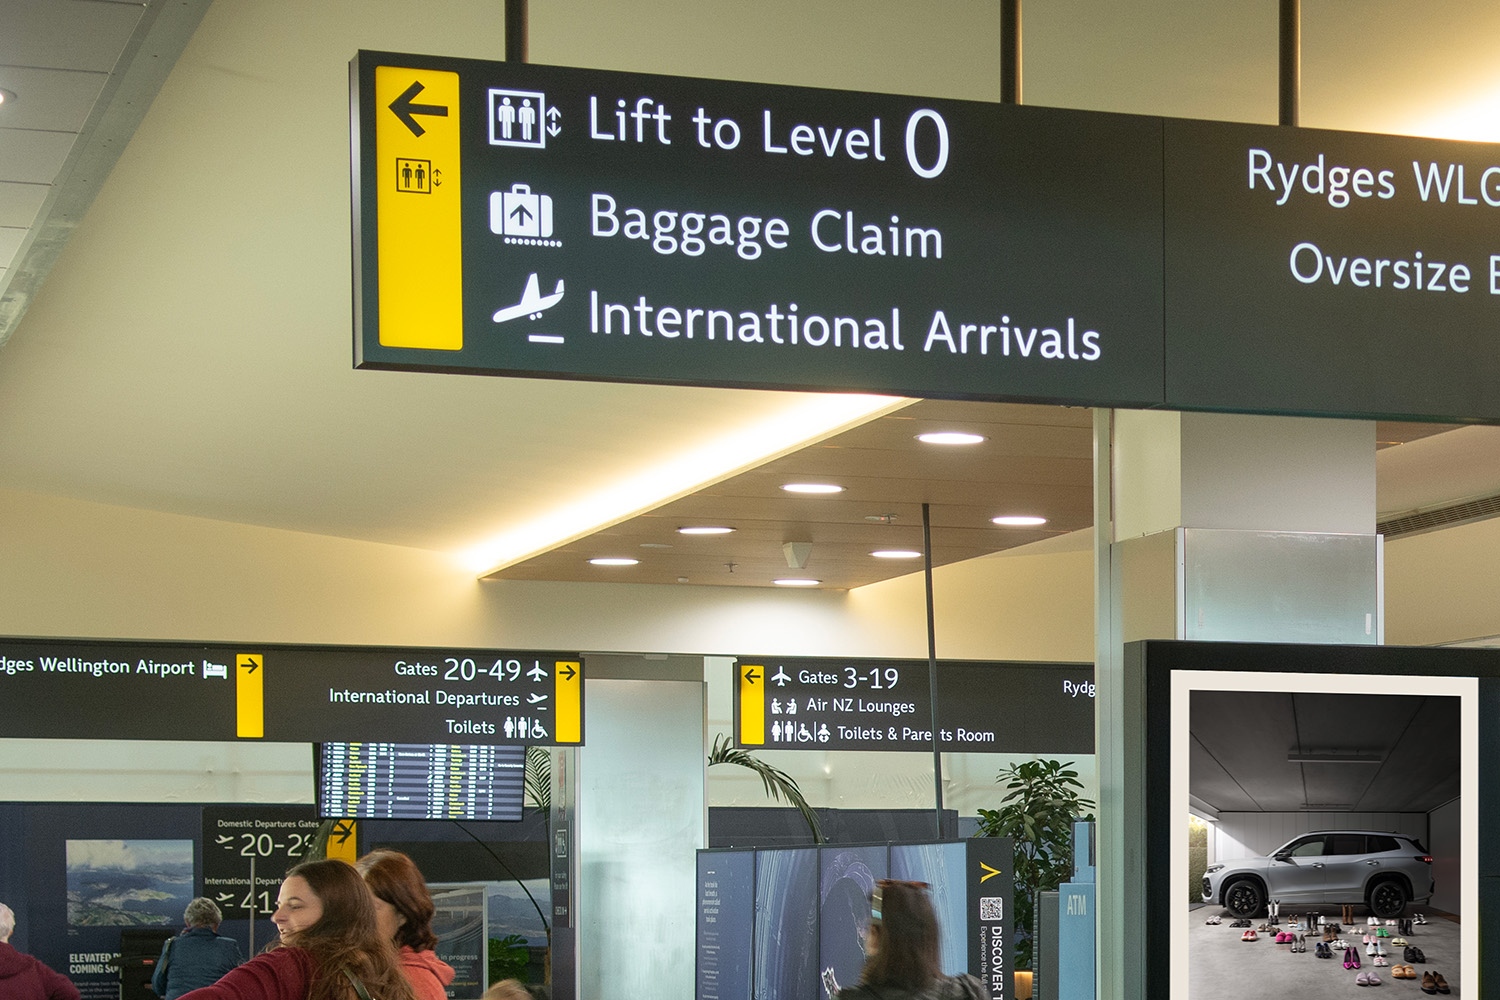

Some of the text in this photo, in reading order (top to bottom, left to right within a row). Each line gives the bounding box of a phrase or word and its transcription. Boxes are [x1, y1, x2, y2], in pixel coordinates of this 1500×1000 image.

[590, 96, 949, 178] Lift to Level 0
[1248, 148, 1395, 208] Rydges
[591, 194, 943, 260] Baggage Claim
[1289, 242, 1471, 294] Oversize
[591, 291, 1101, 362] International Arrivals
[0, 656, 195, 678] dges Wellington Airport
[395, 658, 521, 681] Gates 20-49
[799, 667, 899, 689] Gates 3-19
[329, 688, 520, 709] International Departures
[807, 698, 915, 716] Air NZ Lounges
[446, 719, 496, 736] Toilets
[838, 725, 995, 743] Toilets & Parets Room
[218, 820, 319, 829] Domestic Departures Gates
[205, 877, 282, 887] Internationa Depart
[1066, 895, 1087, 916] ATM
[69, 953, 112, 963] ELEVATED
[992, 926, 1003, 992] DISCOVER
[69, 964, 104, 974] COMING
